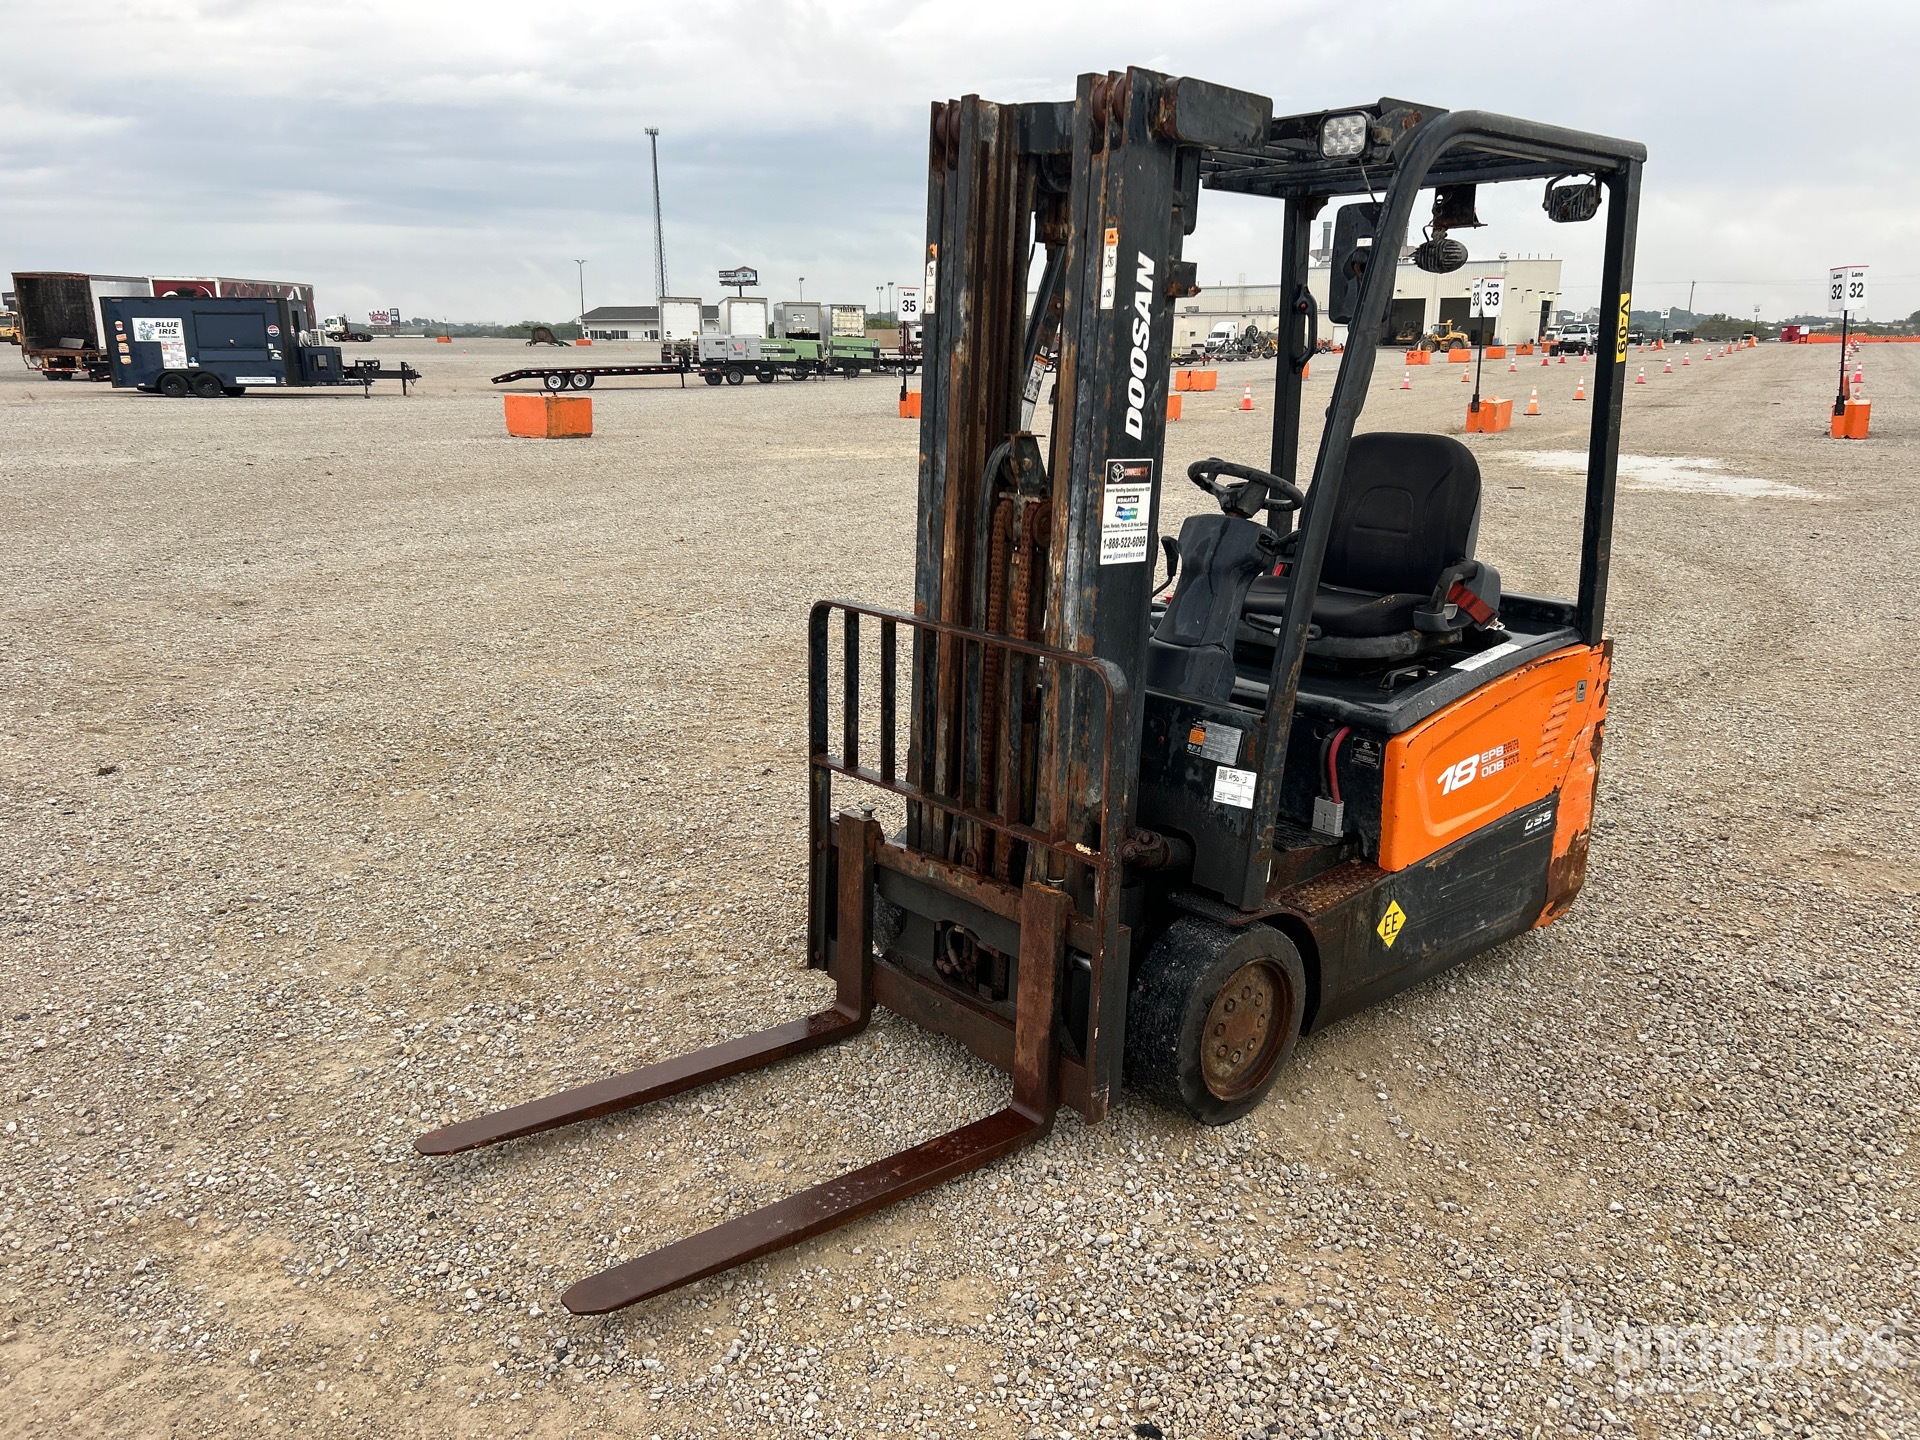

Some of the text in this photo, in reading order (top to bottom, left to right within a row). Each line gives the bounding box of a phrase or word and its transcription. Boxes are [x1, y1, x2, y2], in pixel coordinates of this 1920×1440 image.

[1485, 291, 1500, 306] 33
[1831, 283, 1843, 300] 32
[1849, 282, 1864, 298] 32
[902, 299, 916, 313] 35
[1472, 291, 1480, 307] 33
[1617, 299, 1630, 355] V-09
[1125, 250, 1155, 441] DOOSAN
[1103, 535, 1146, 549] 1-888-522-6099
[1437, 753, 1480, 796] 18
[1481, 745, 1504, 764] EPB
[1481, 759, 1505, 778] ODB
[1383, 911, 1399, 937] EE
